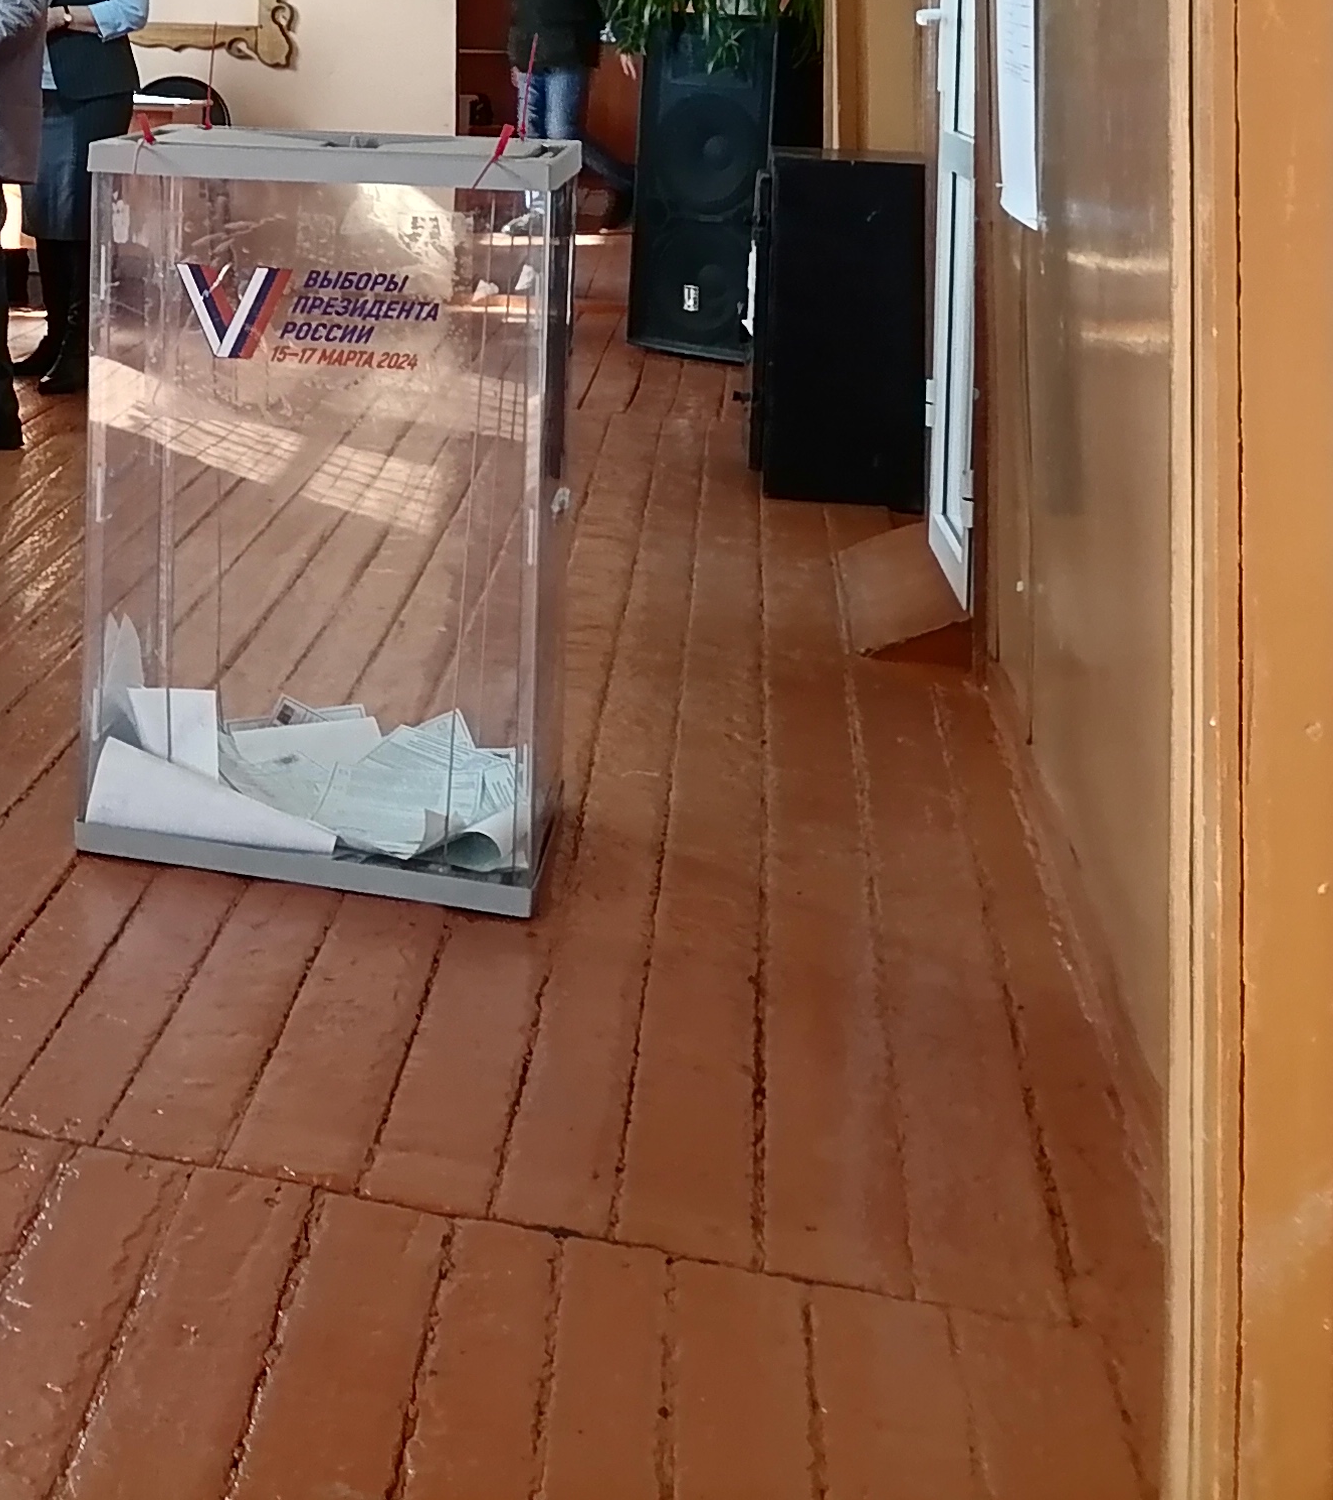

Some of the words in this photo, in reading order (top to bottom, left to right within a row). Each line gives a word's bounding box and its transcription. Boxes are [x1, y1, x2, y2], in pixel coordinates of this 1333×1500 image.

[303, 269, 410, 294] ВЫБОРЫ
[291, 295, 441, 323] ПРЕЗИДЕНТА
[278, 320, 376, 345] РОССИИ
[316, 348, 375, 370] МАРТА
[376, 351, 420, 372] 2024
